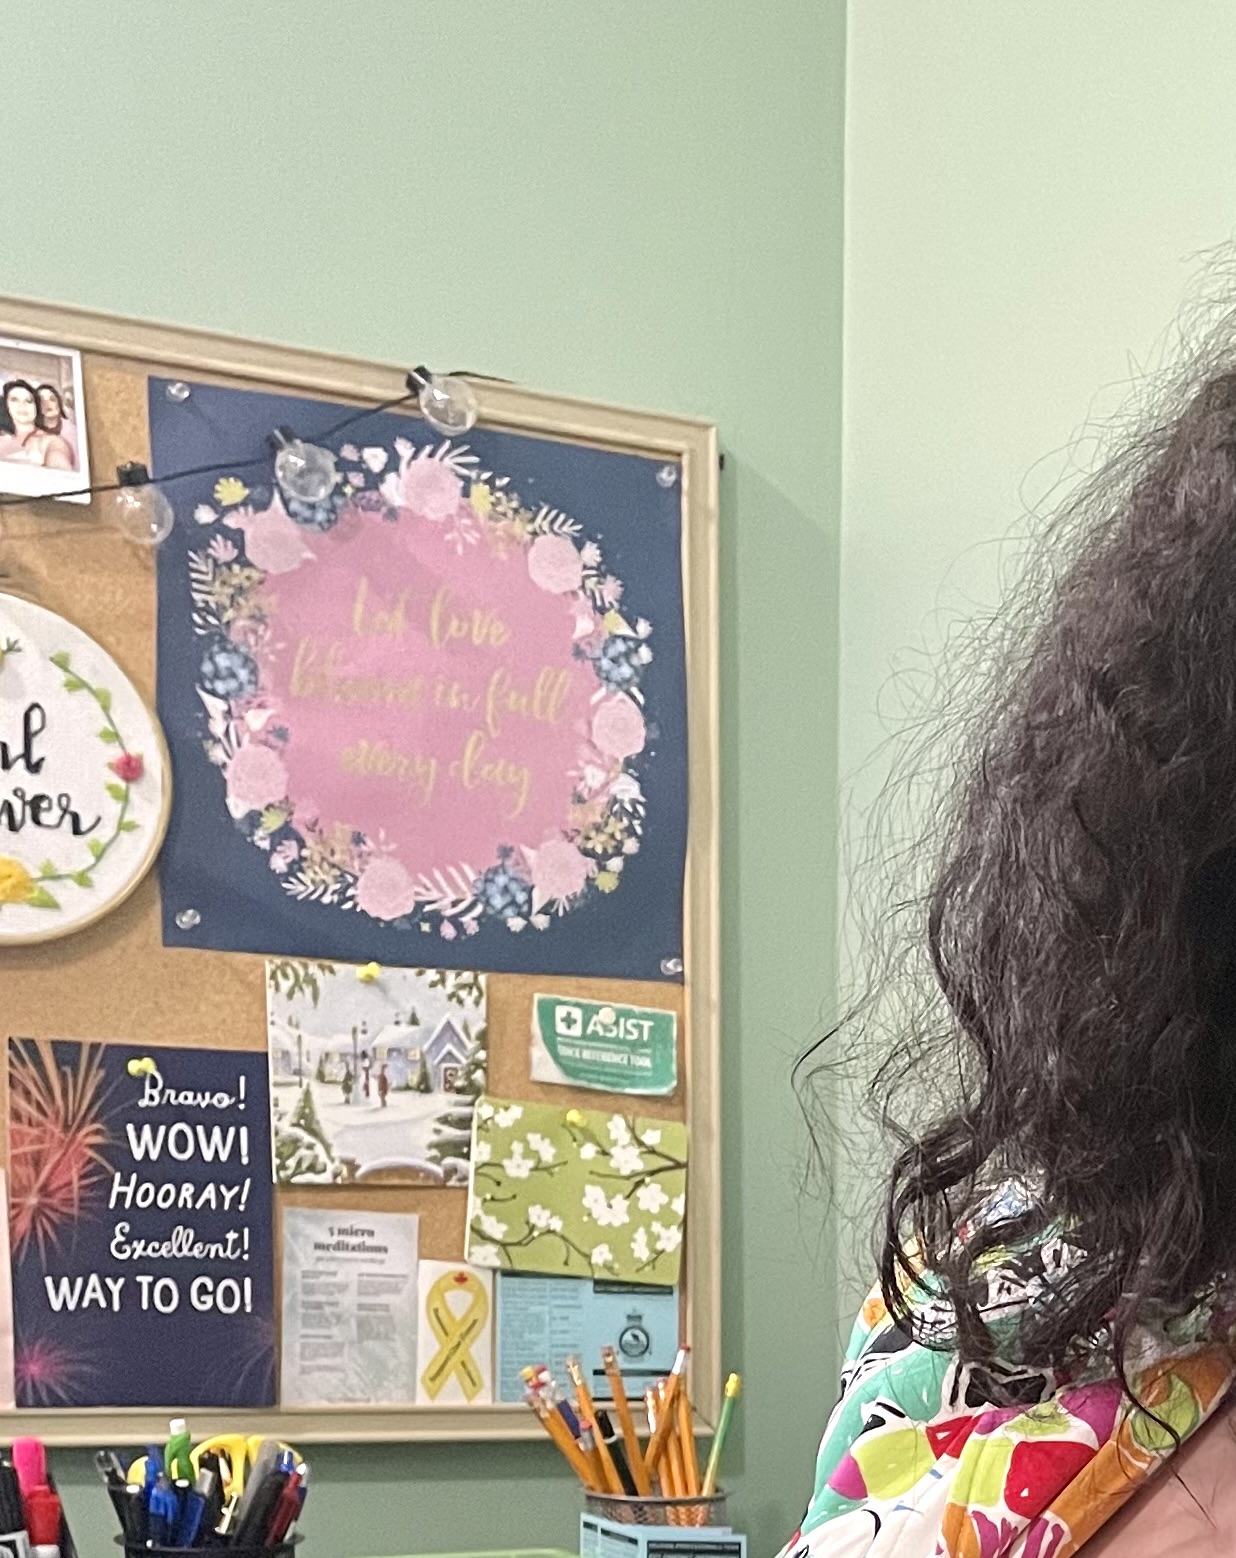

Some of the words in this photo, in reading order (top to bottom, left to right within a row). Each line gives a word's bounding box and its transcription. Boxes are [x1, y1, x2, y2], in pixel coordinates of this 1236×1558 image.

[486, 667, 572, 738] full
[449, 730, 532, 820] day
[138, 1071, 246, 1110] Bravo!
[126, 1122, 249, 1165] WOW!
[108, 1172, 251, 1212] HOORAY!
[110, 1221, 250, 1261] Excellent!
[313, 1240, 389, 1254] meditations
[44, 1273, 125, 1312] WAY
[135, 1275, 179, 1314] TO
[190, 1275, 252, 1315] GO!
